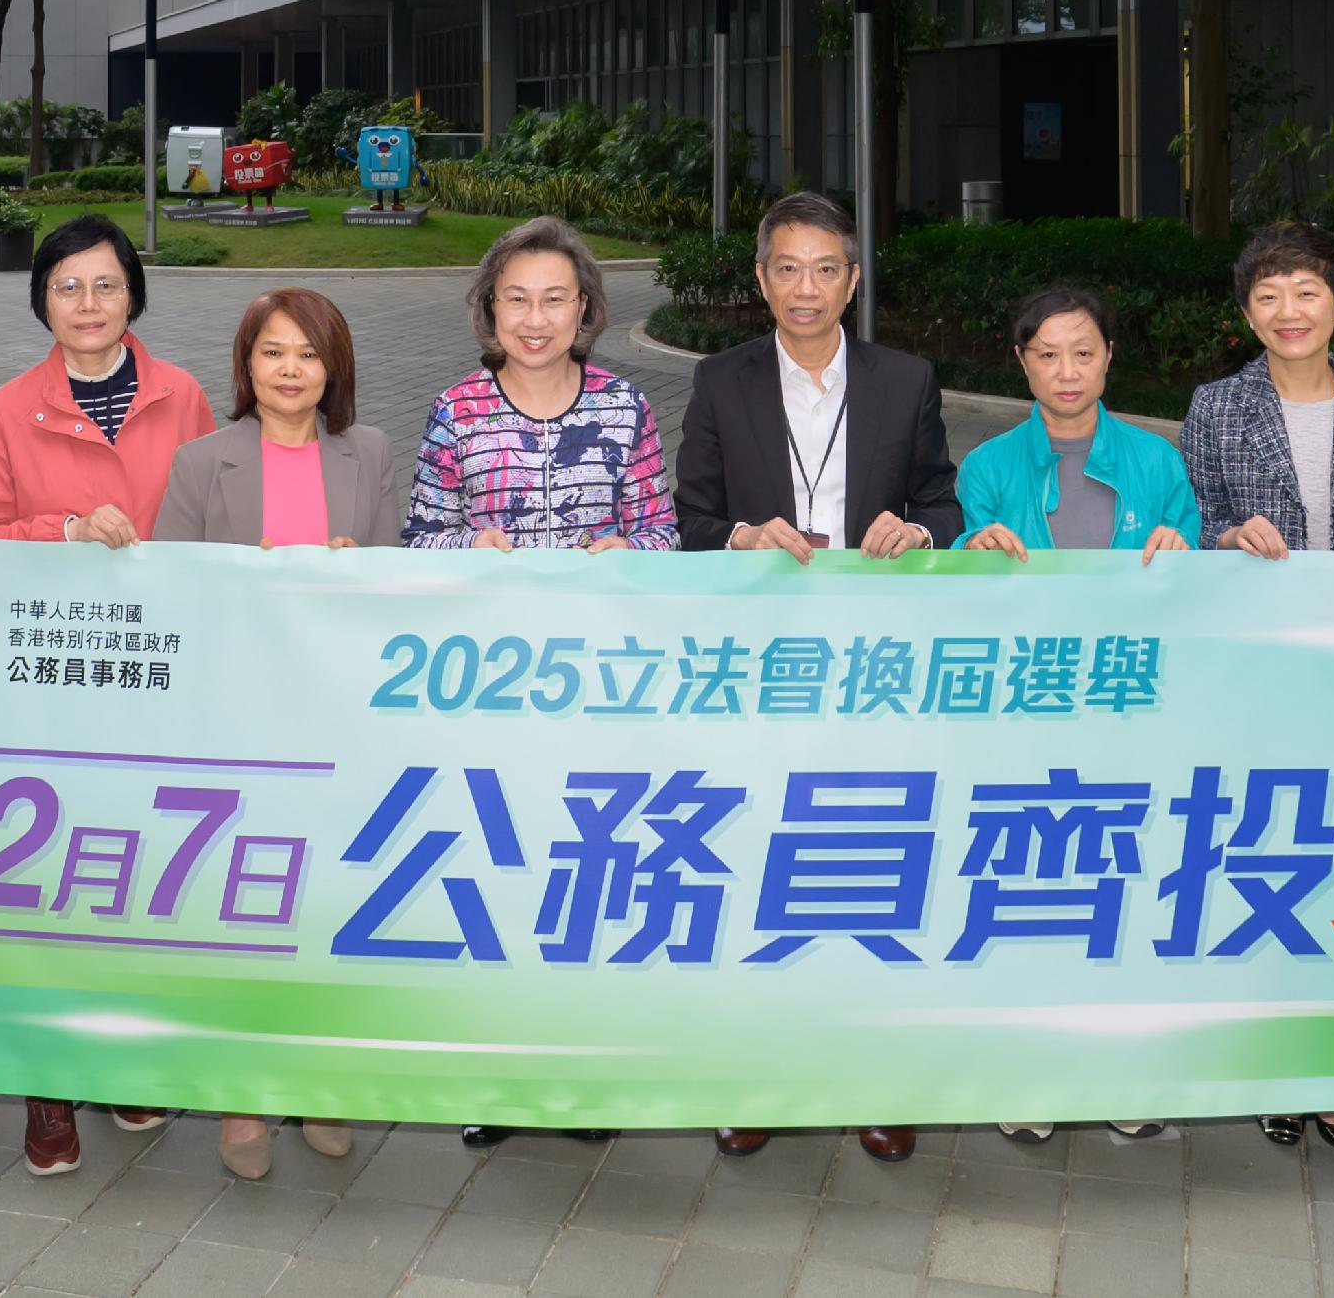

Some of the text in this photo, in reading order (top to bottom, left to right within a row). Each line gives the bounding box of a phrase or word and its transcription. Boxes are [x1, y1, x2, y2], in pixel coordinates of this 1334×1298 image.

[10, 600, 142, 623] 中華人民共和國
[8, 628, 181, 653] 香港特別行政區政府
[7, 656, 170, 690] 公務員事務局
[369, 633, 1161, 715] 2025立法會換屆選舉
